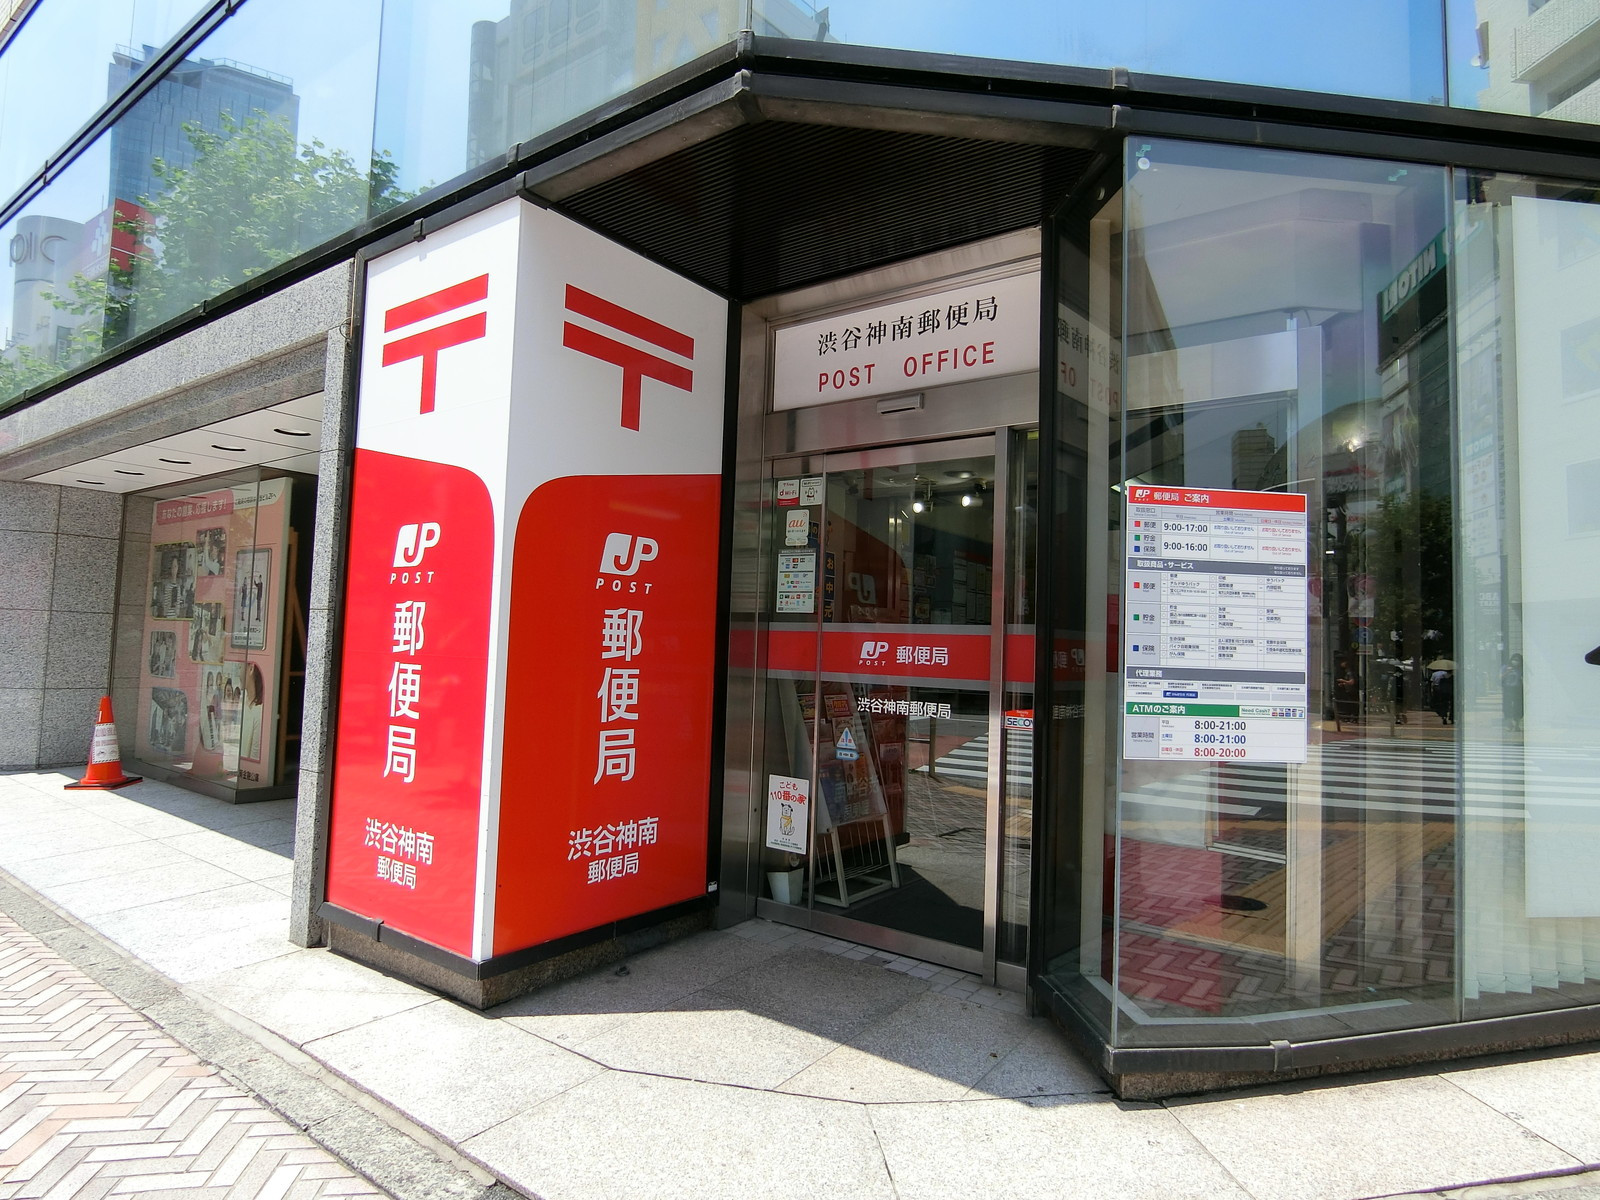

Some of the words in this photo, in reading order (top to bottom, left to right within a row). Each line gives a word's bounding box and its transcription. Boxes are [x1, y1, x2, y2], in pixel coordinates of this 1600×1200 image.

[817, 295, 998, 356] 渋谷神南郵便局
[818, 363, 876, 392] POST
[903, 341, 995, 377] OFFICE
[1153, 491, 1180, 502] 郵便局
[1183, 493, 1210, 504] ご案内
[788, 519, 806, 529] au
[1163, 522, 1208, 533] 9:00-17:00
[393, 522, 441, 568] JP
[1163, 541, 1208, 552] 9:00-16:00
[599, 532, 659, 576] JP
[390, 571, 434, 584] POST
[595, 578, 652, 594] POST
[860, 641, 889, 659] JP
[896, 645, 949, 666] 郵便局
[858, 659, 886, 667] POST
[383, 600, 426, 783] 郵便局
[593, 607, 644, 785] 郵便局
[857, 697, 952, 720] 渋谷神南郵便局
[1132, 704, 1186, 715] ATMのご案内
[1194, 720, 1247, 731] 8:00-21:00
[1194, 733, 1247, 745] 8:00-21:00
[1194, 747, 1247, 758] 8:00-20:00
[779, 781, 798, 790] こども
[770, 790, 807, 805] 110番の家
[364, 817, 435, 865] 渋谷神南
[567, 816, 659, 861] 渋谷神南
[376, 855, 417, 890] 郵便局
[587, 852, 639, 885] 郵便局
